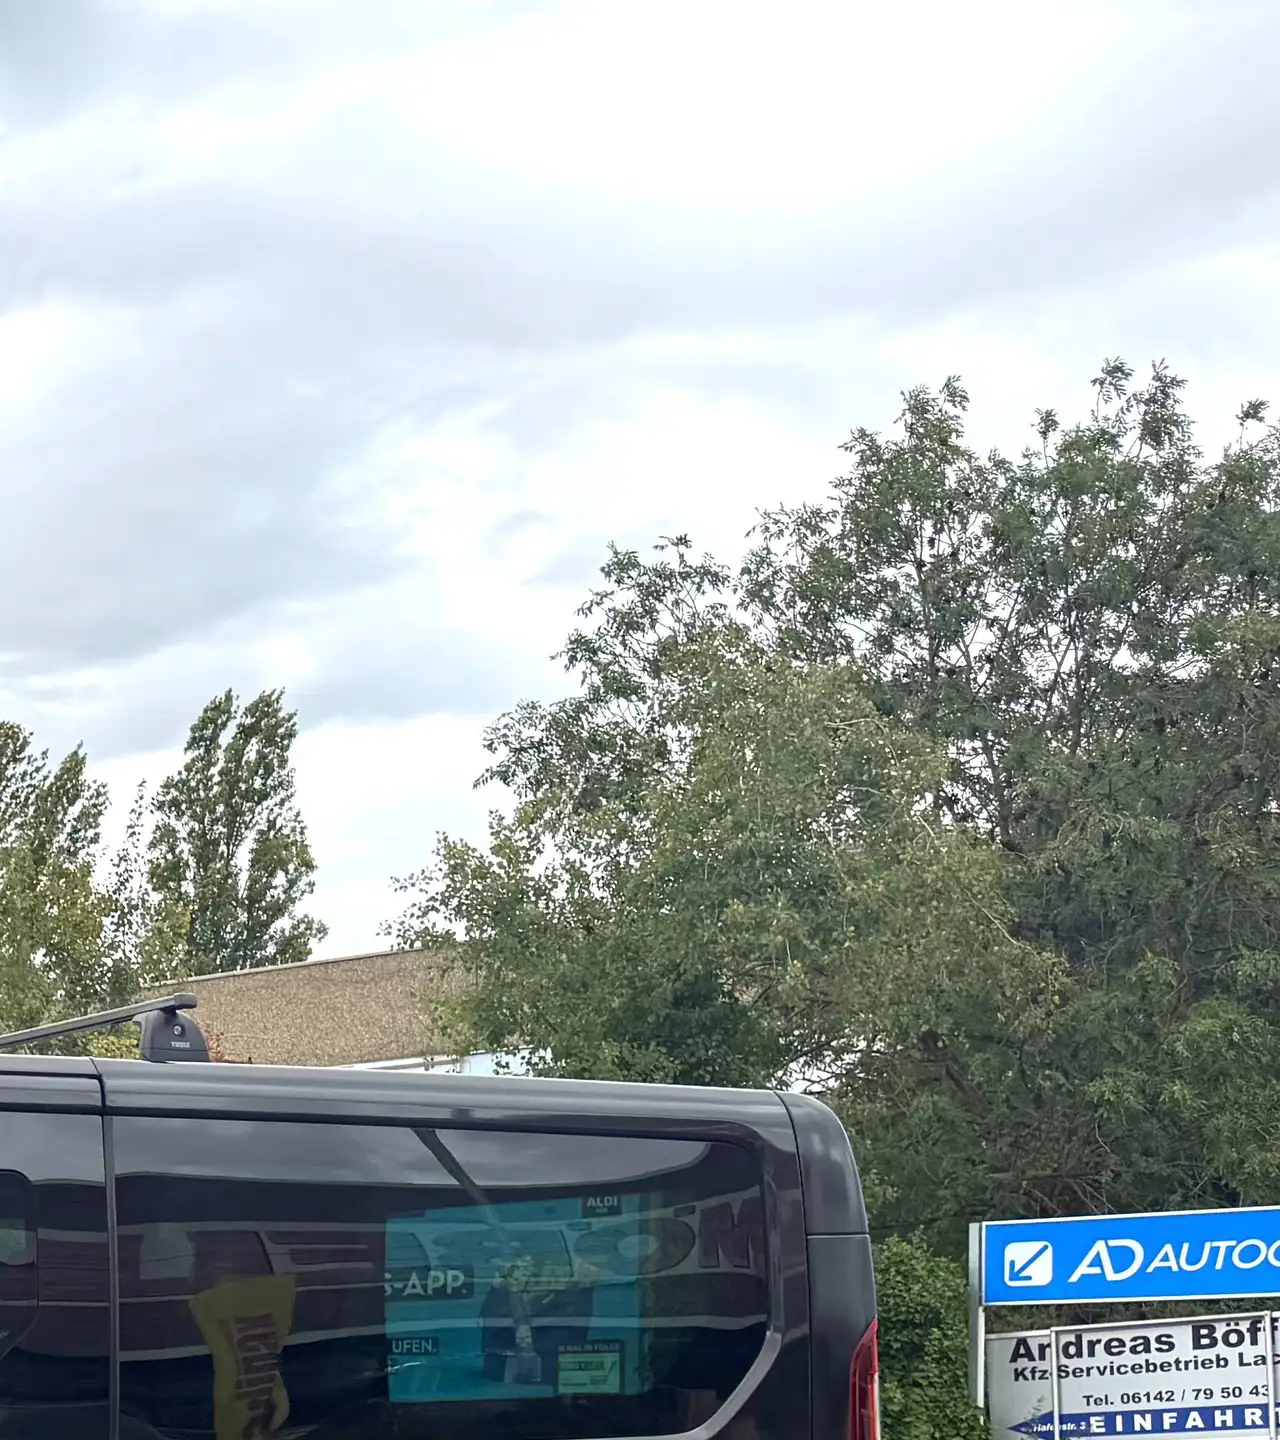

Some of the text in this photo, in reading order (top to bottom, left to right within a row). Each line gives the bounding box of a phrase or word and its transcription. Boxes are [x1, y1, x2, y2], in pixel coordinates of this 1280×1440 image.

[586, 1196, 618, 1207] ALDI
[1067, 1238, 1144, 1283] AD
[1009, 1333, 1176, 1364] Andreas
[1014, 1353, 1229, 1382] Kfz-Servicebetrieb
[1083, 1394, 1114, 1406] Tel.
[1120, 1390, 1175, 1405] 06142
[1192, 1387, 1214, 1400] 79
[1221, 1386, 1242, 1398] 50
